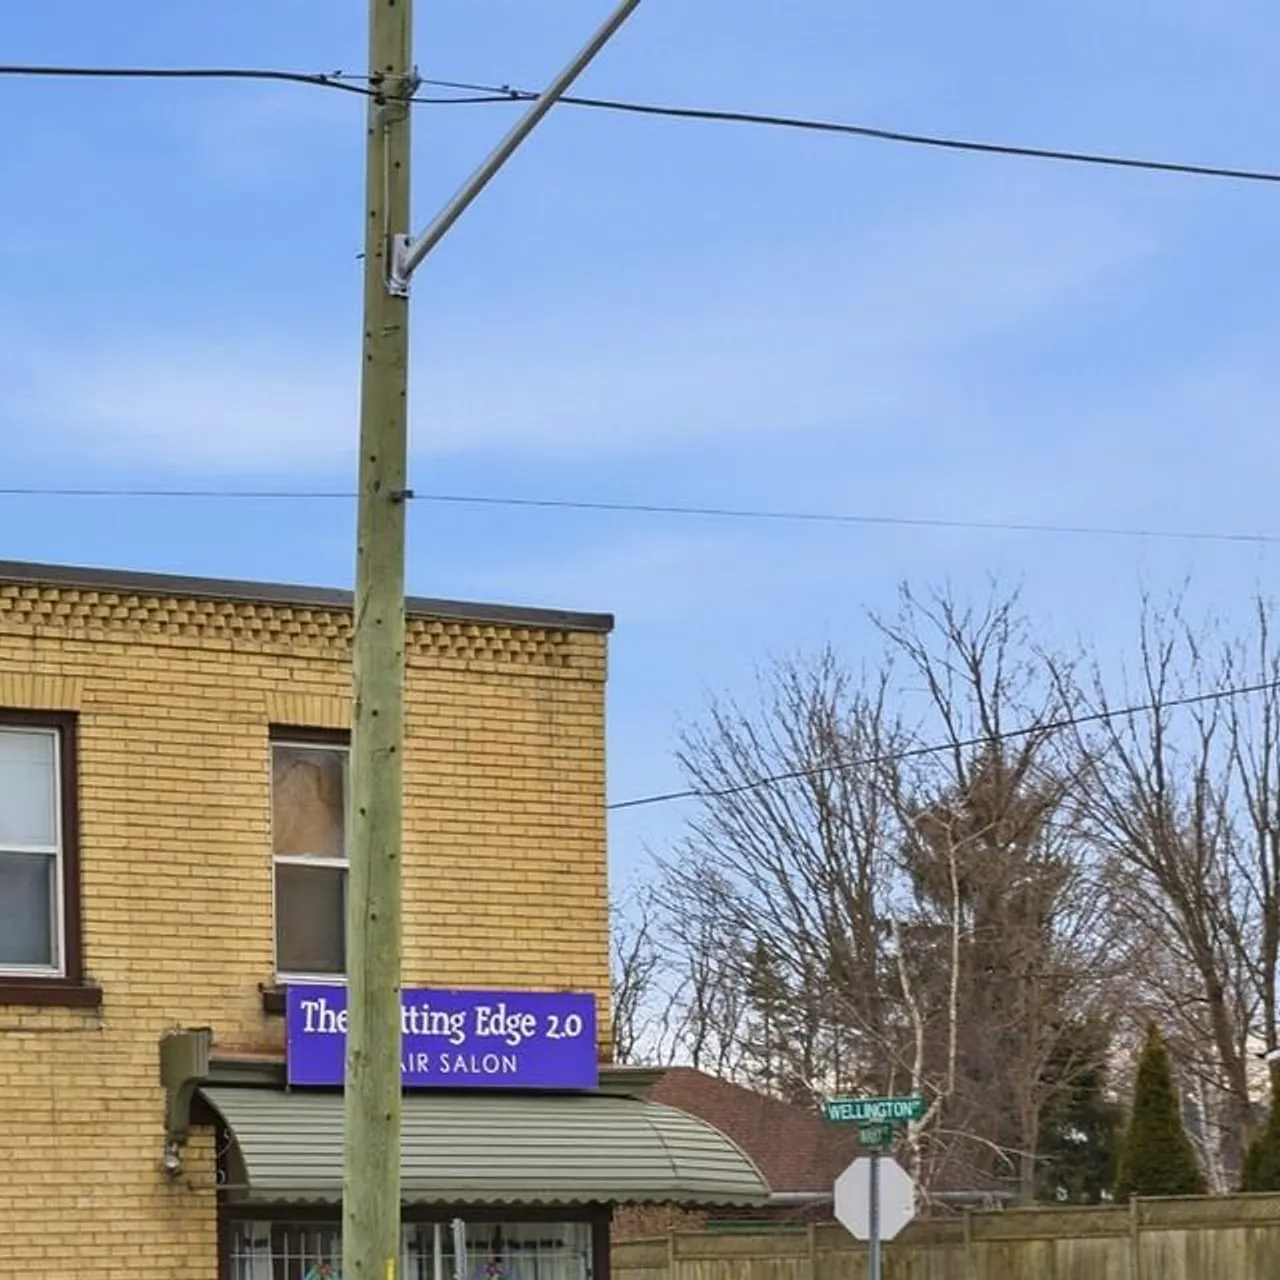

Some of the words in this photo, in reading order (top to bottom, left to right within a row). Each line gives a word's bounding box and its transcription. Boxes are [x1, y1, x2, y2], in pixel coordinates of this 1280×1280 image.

[301, 998, 347, 1033] The
[401, 1003, 466, 1045] tting
[474, 1003, 537, 1046] Edge
[546, 1014, 583, 1039] 2.0
[440, 1054, 517, 1074] SALON
[828, 1102, 913, 1120] WELLINGTON
